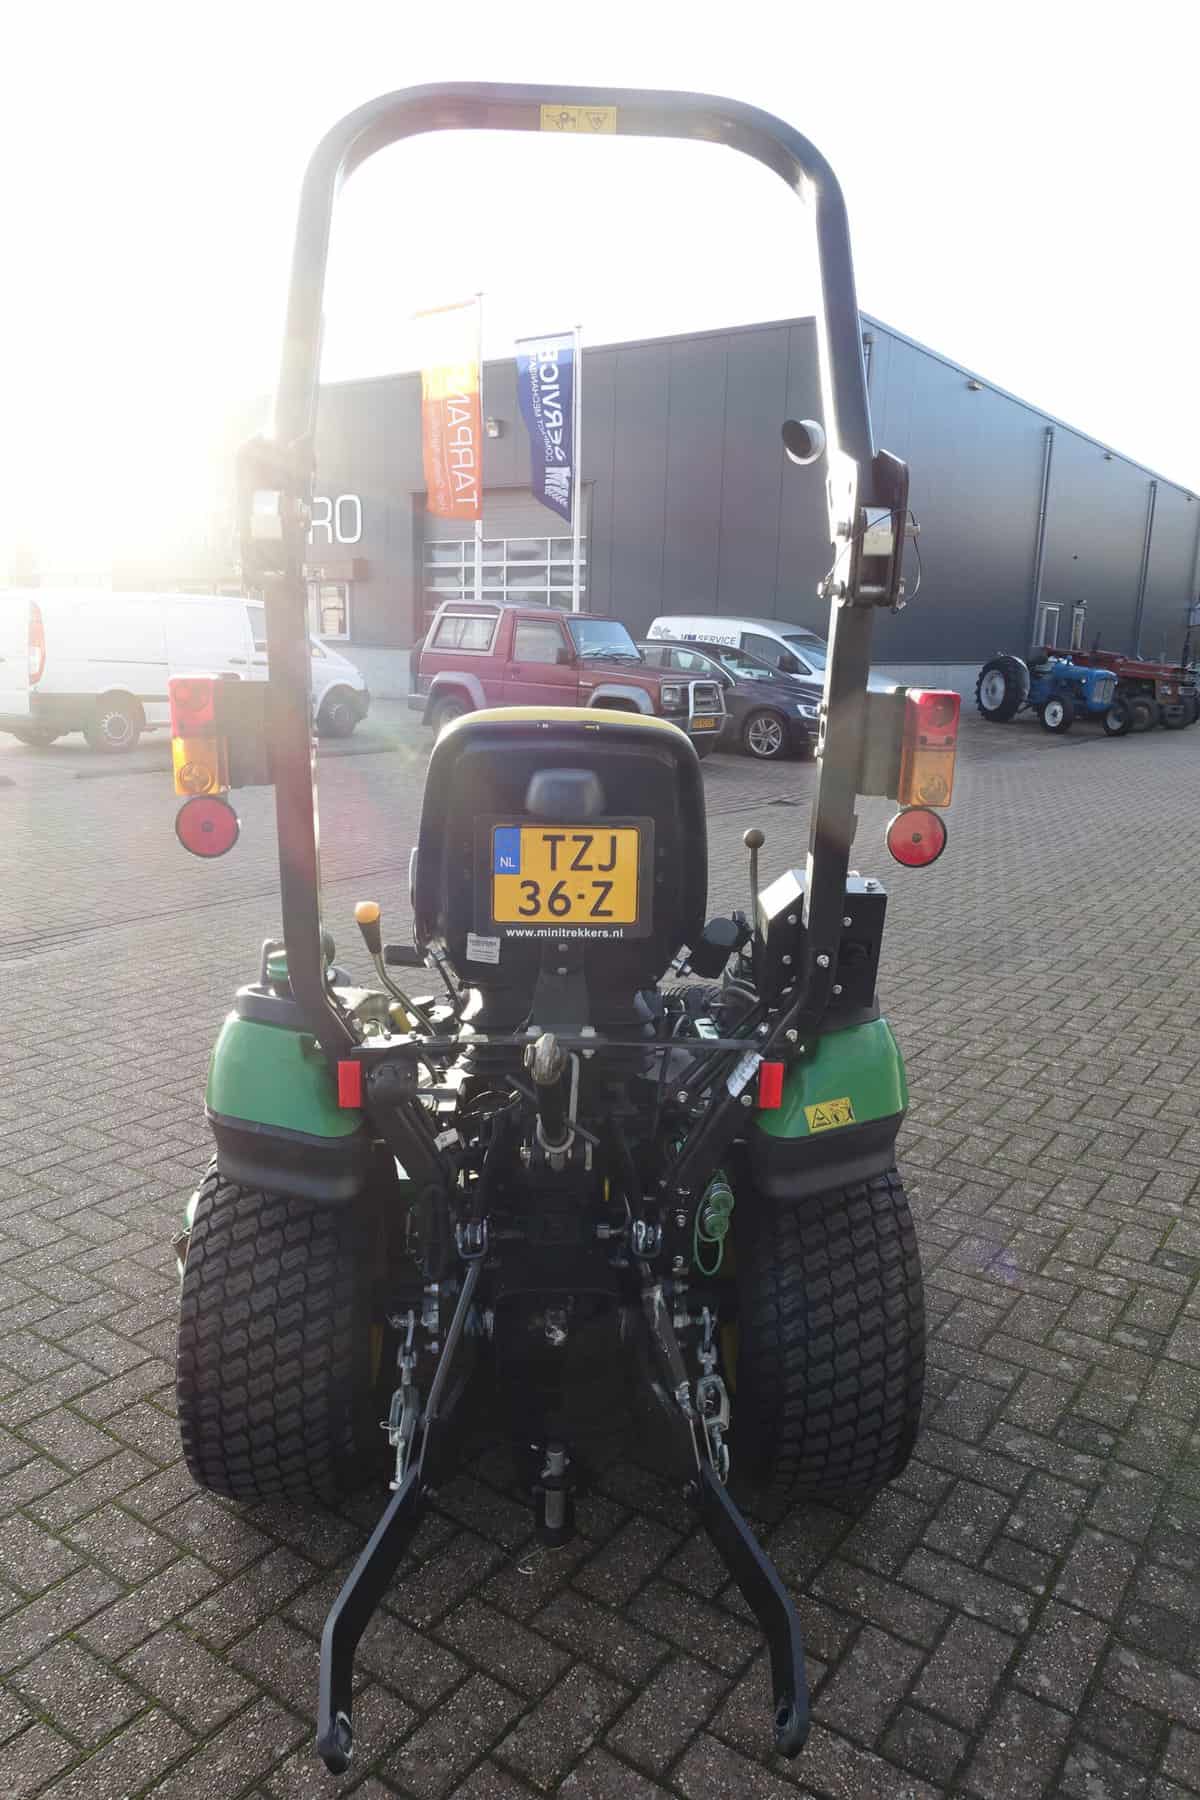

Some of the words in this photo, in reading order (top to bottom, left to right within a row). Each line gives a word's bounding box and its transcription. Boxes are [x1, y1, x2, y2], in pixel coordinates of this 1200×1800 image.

[542, 835, 617, 872] TZJ
[500, 856, 516, 868] NL
[506, 928, 624, 938] www.minitrekkers.nl
